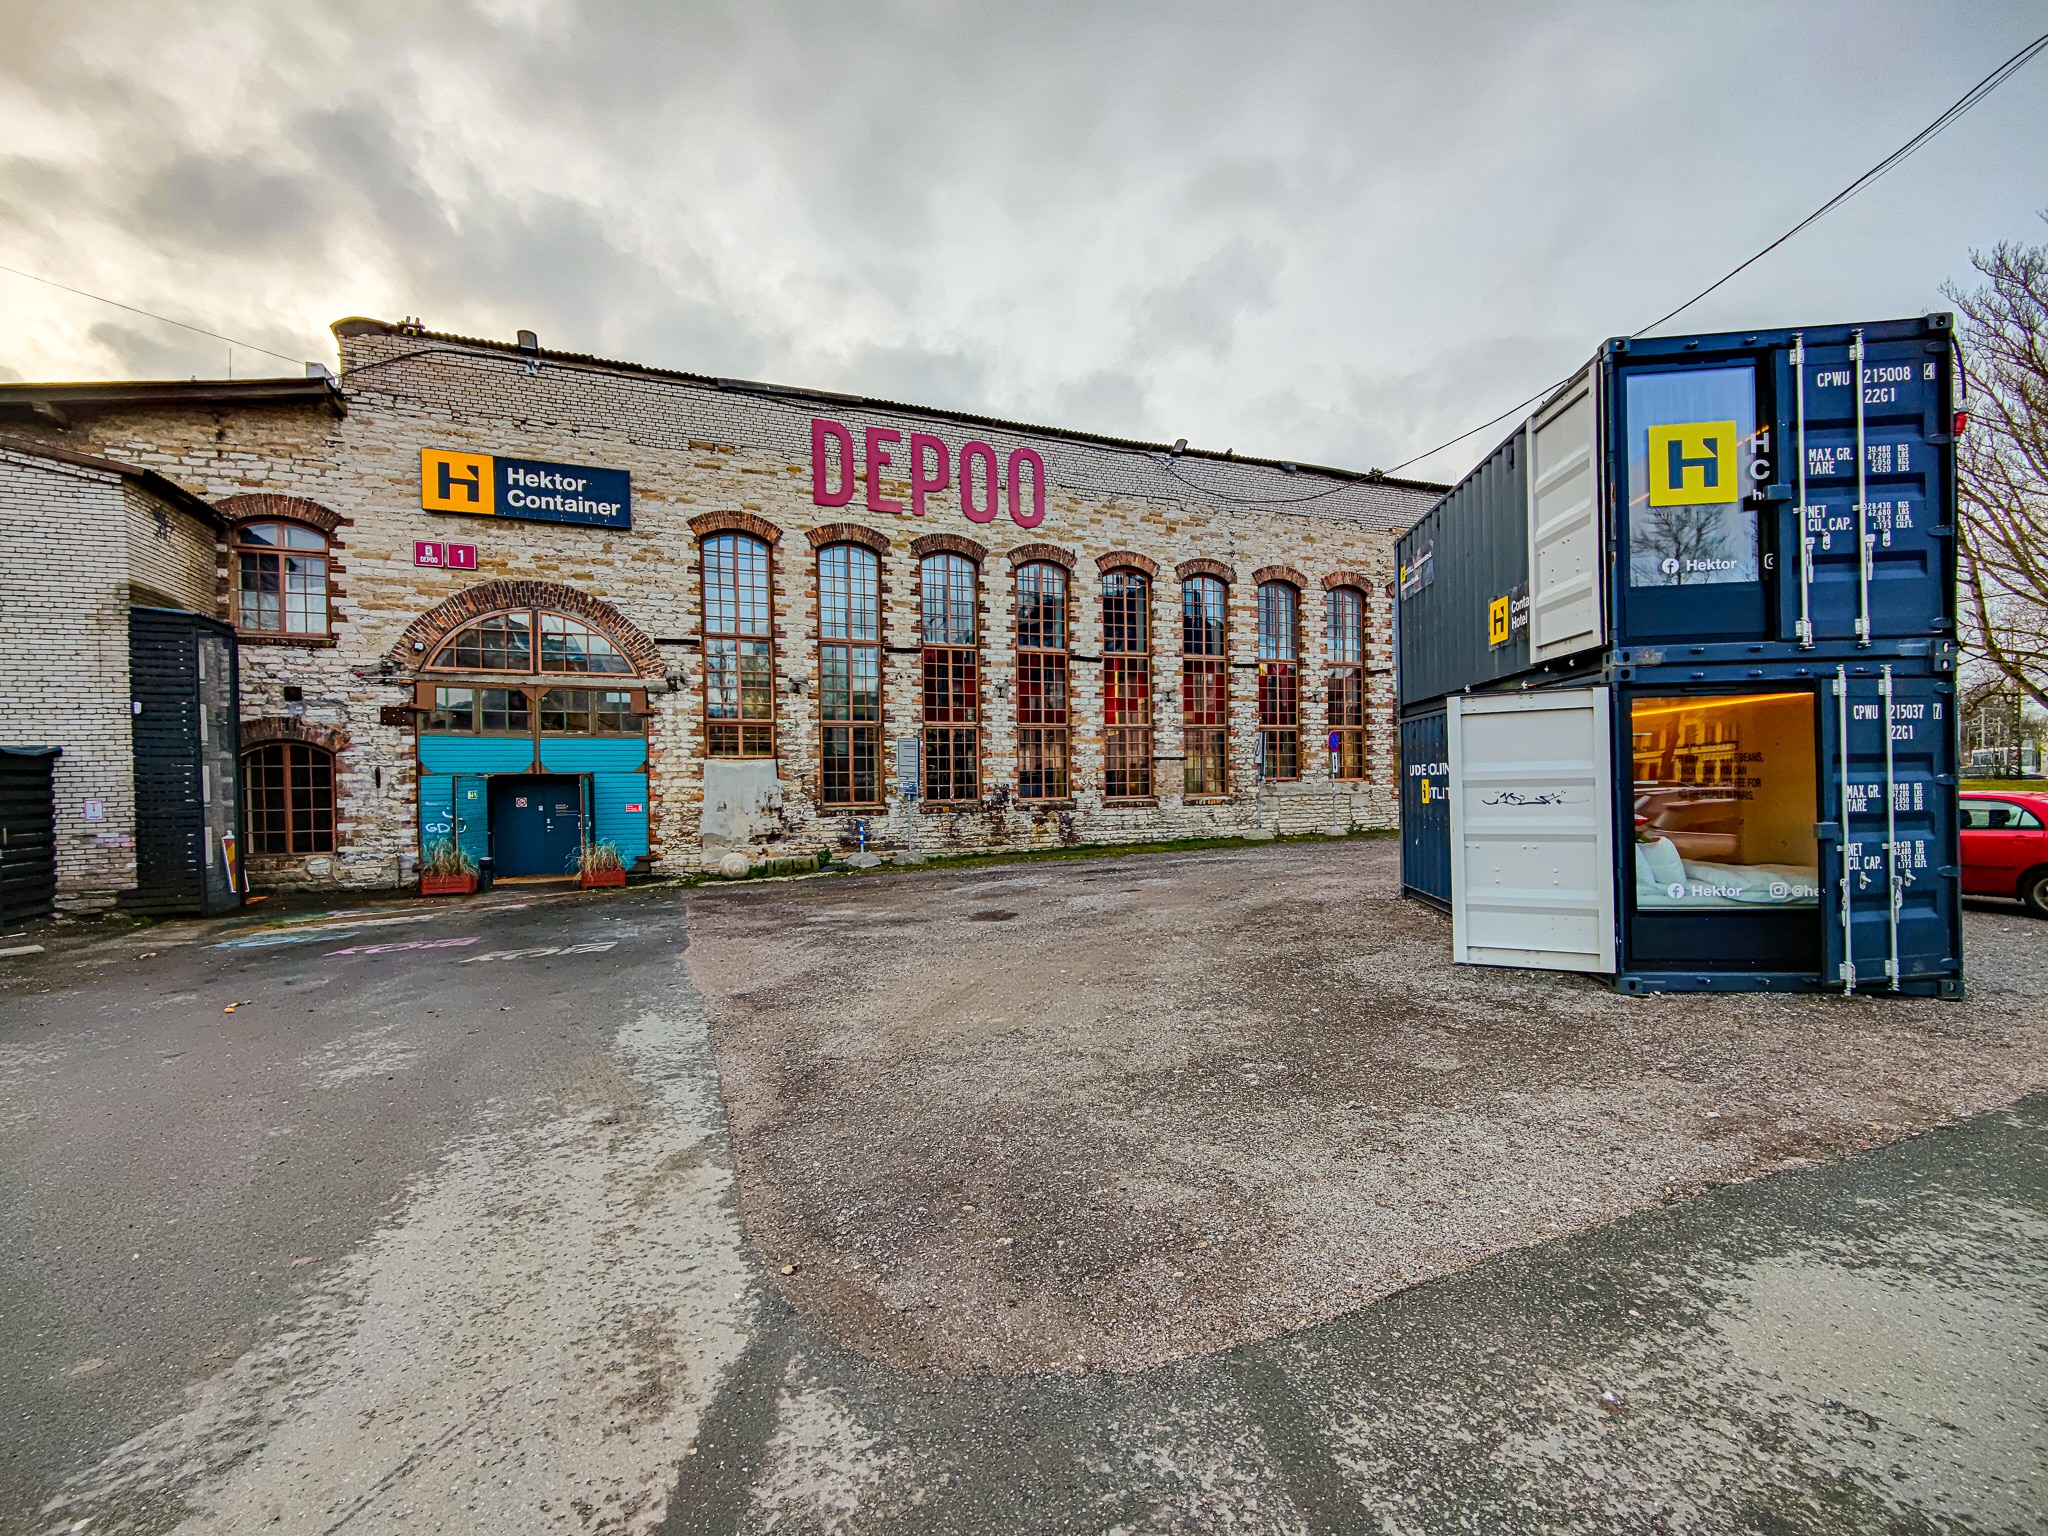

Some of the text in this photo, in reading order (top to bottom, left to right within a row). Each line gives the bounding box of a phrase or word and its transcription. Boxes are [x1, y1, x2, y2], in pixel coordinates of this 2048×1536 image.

[1817, 363, 1934, 387] CPWU 215008 4
[1864, 388, 1895, 403] 22G1
[1809, 447, 1854, 461] MAX. GR.
[811, 418, 1045, 529] DEPOO
[1809, 461, 1835, 475] TARE
[1898, 464, 1909, 472] LBS
[507, 467, 587, 492] Hektor
[507, 489, 621, 516] Container
[1808, 505, 1826, 518] NET
[1808, 517, 1853, 532] CU. CAP.
[457, 549, 464, 563] 1
[1686, 558, 1737, 572] Hektor
[1511, 610, 1528, 630] Hotel
[1853, 704, 1941, 720] CPWU 215037 7
[1891, 725, 1914, 740] 22G1
[1747, 778, 1761, 788] FOR
[1734, 790, 1755, 801] PARIS.
[1846, 784, 1881, 798] MAX. GR.
[1847, 798, 1867, 812] TARE
[1848, 843, 1862, 856] NET
[1848, 856, 1883, 870] CU. CAP.
[1692, 885, 1743, 897] Hektor
